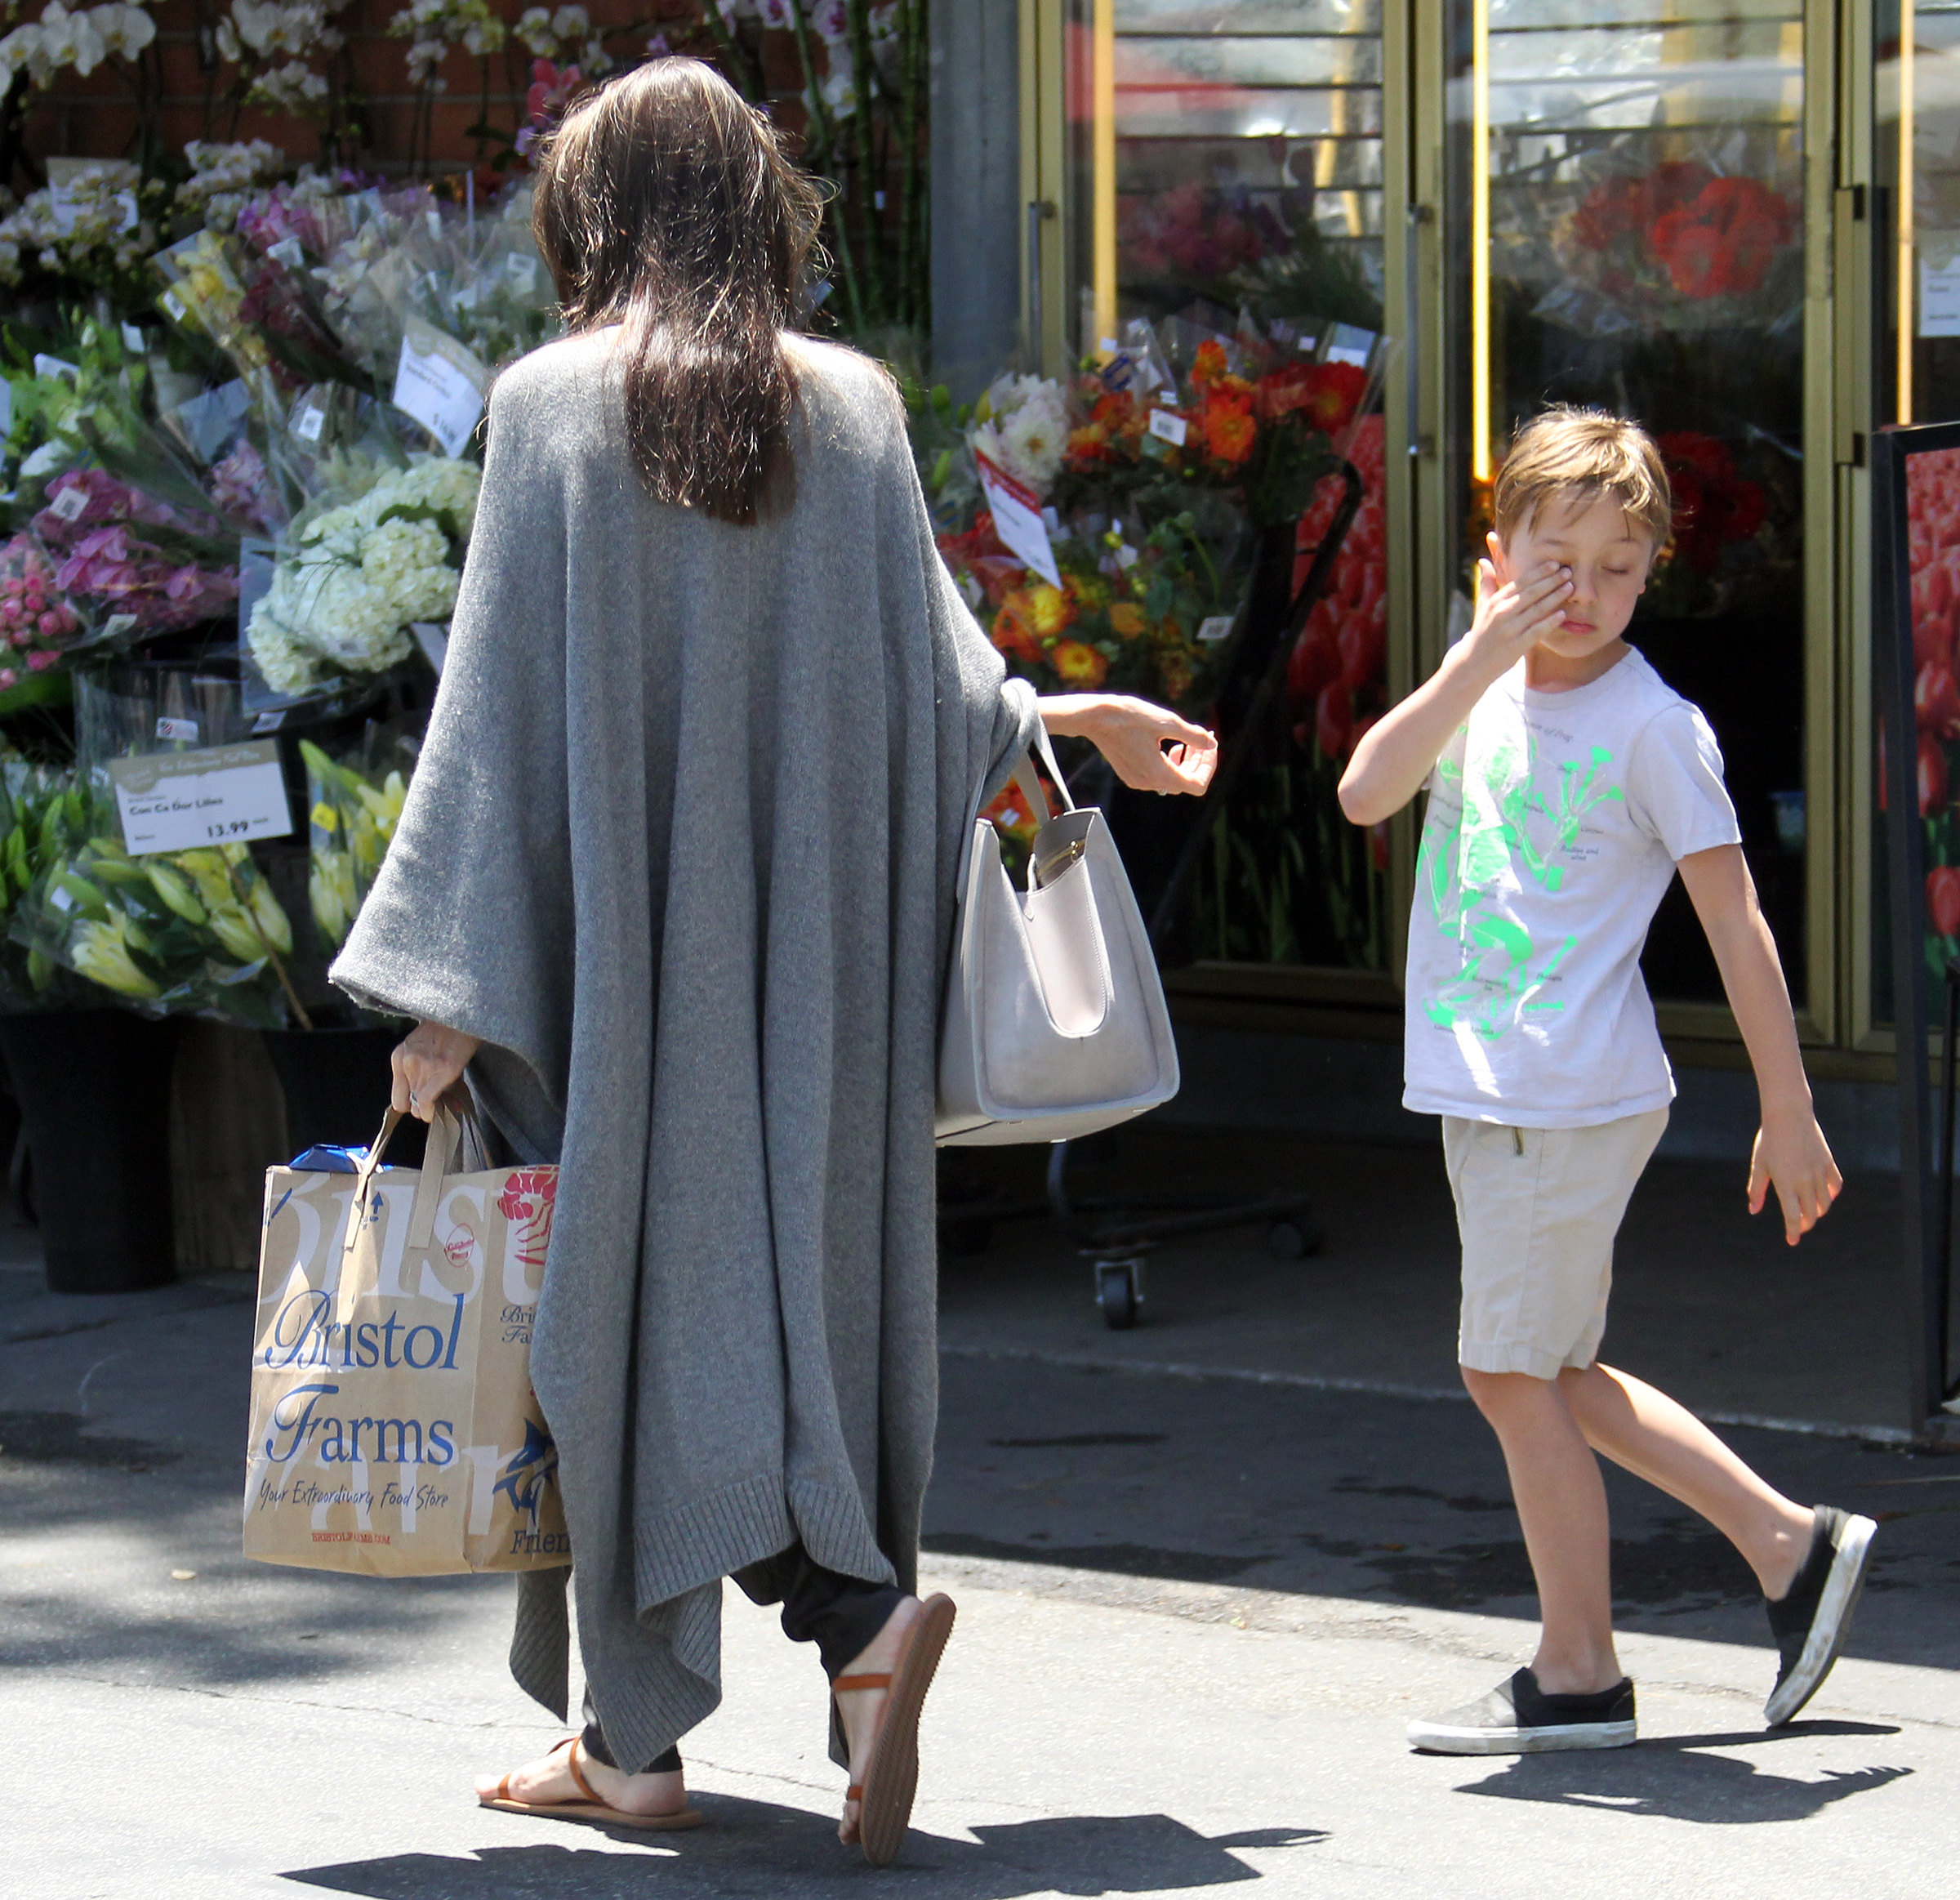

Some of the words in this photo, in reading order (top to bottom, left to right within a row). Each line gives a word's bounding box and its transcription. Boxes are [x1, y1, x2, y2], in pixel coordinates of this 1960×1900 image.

[207, 821, 248, 838] 13.99
[264, 1289, 466, 1370] Bristol
[265, 1384, 453, 1465] Farms
[260, 1479, 287, 1511] Your
[292, 1480, 375, 1514] Extraordinary
[380, 1482, 415, 1508] Food
[415, 1483, 449, 1511] Store
